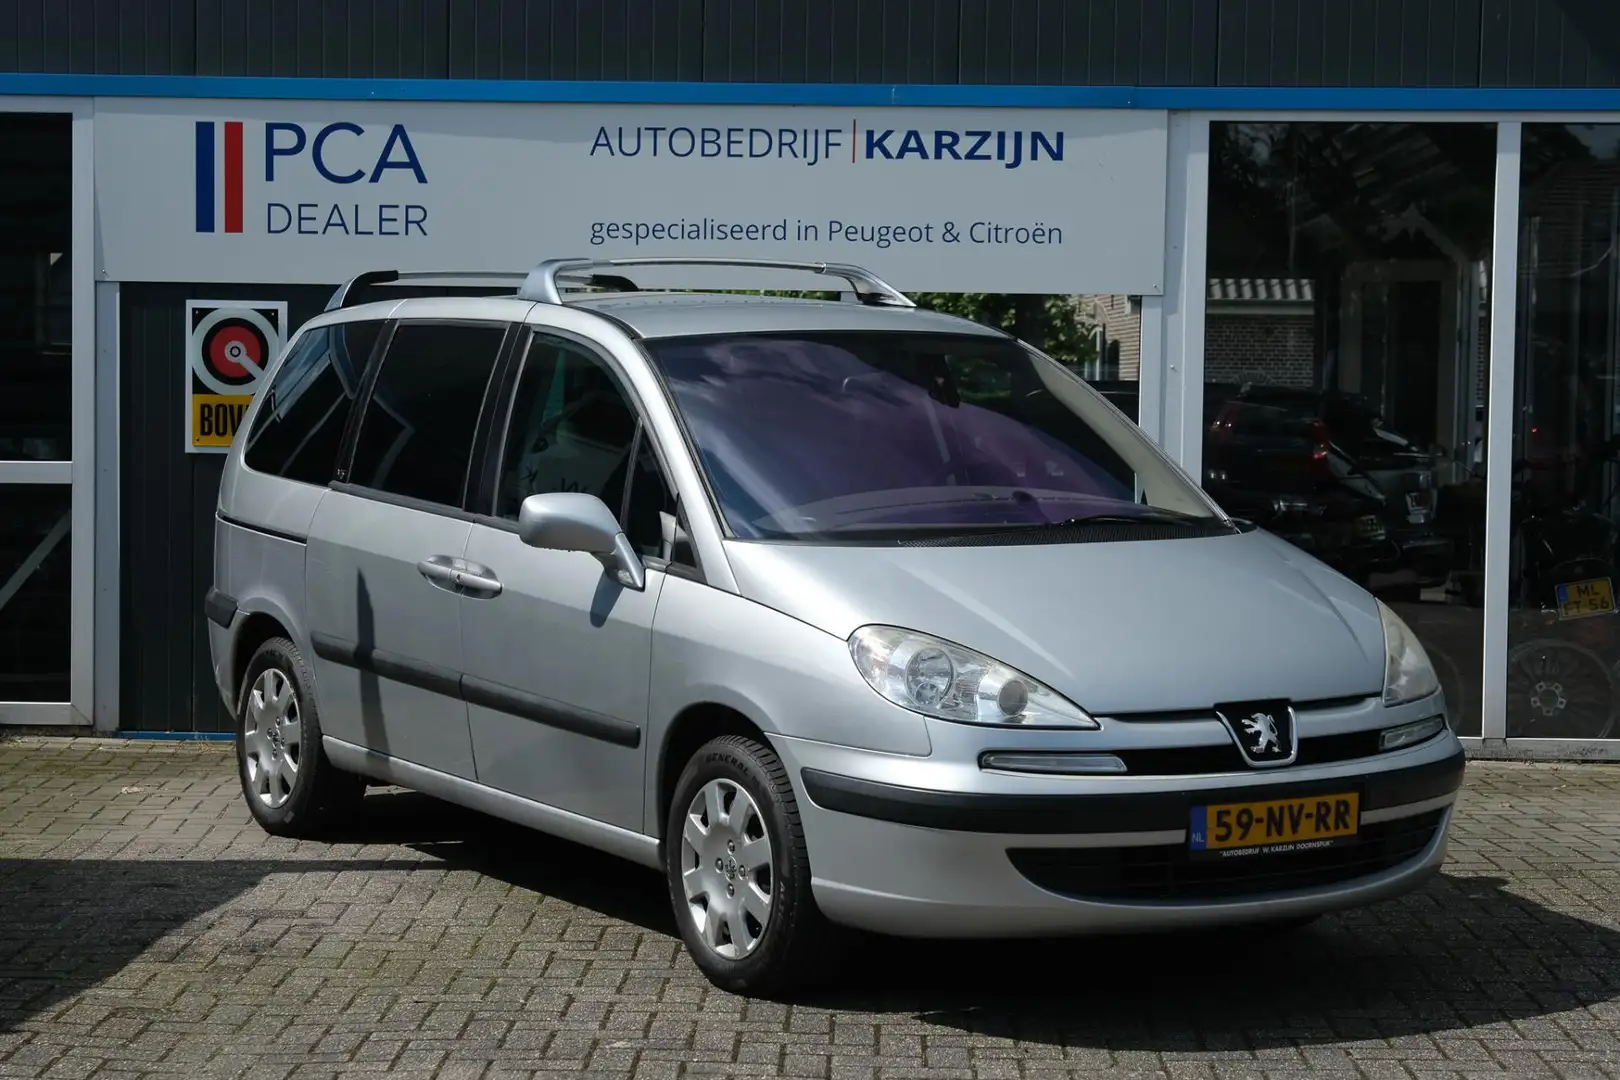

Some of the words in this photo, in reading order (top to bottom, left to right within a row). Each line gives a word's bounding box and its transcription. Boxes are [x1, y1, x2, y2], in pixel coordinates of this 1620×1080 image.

[265, 121, 428, 184] PCA
[590, 126, 842, 166] AUTOBEDRIJF
[865, 129, 1064, 169] KARZIJN
[267, 203, 428, 236] DEALER
[590, 218, 787, 246] gespecialiseerd
[797, 218, 818, 242] in
[828, 221, 933, 249] Peugeot
[942, 222, 960, 243] &
[969, 222, 1063, 245] Citroën
[200, 403, 249, 437] BOV
[1576, 584, 1600, 597] ML
[705, 752, 749, 776] GENERAL
[1191, 832, 1204, 843] NL
[1215, 800, 1350, 842] 59-NV-RR
